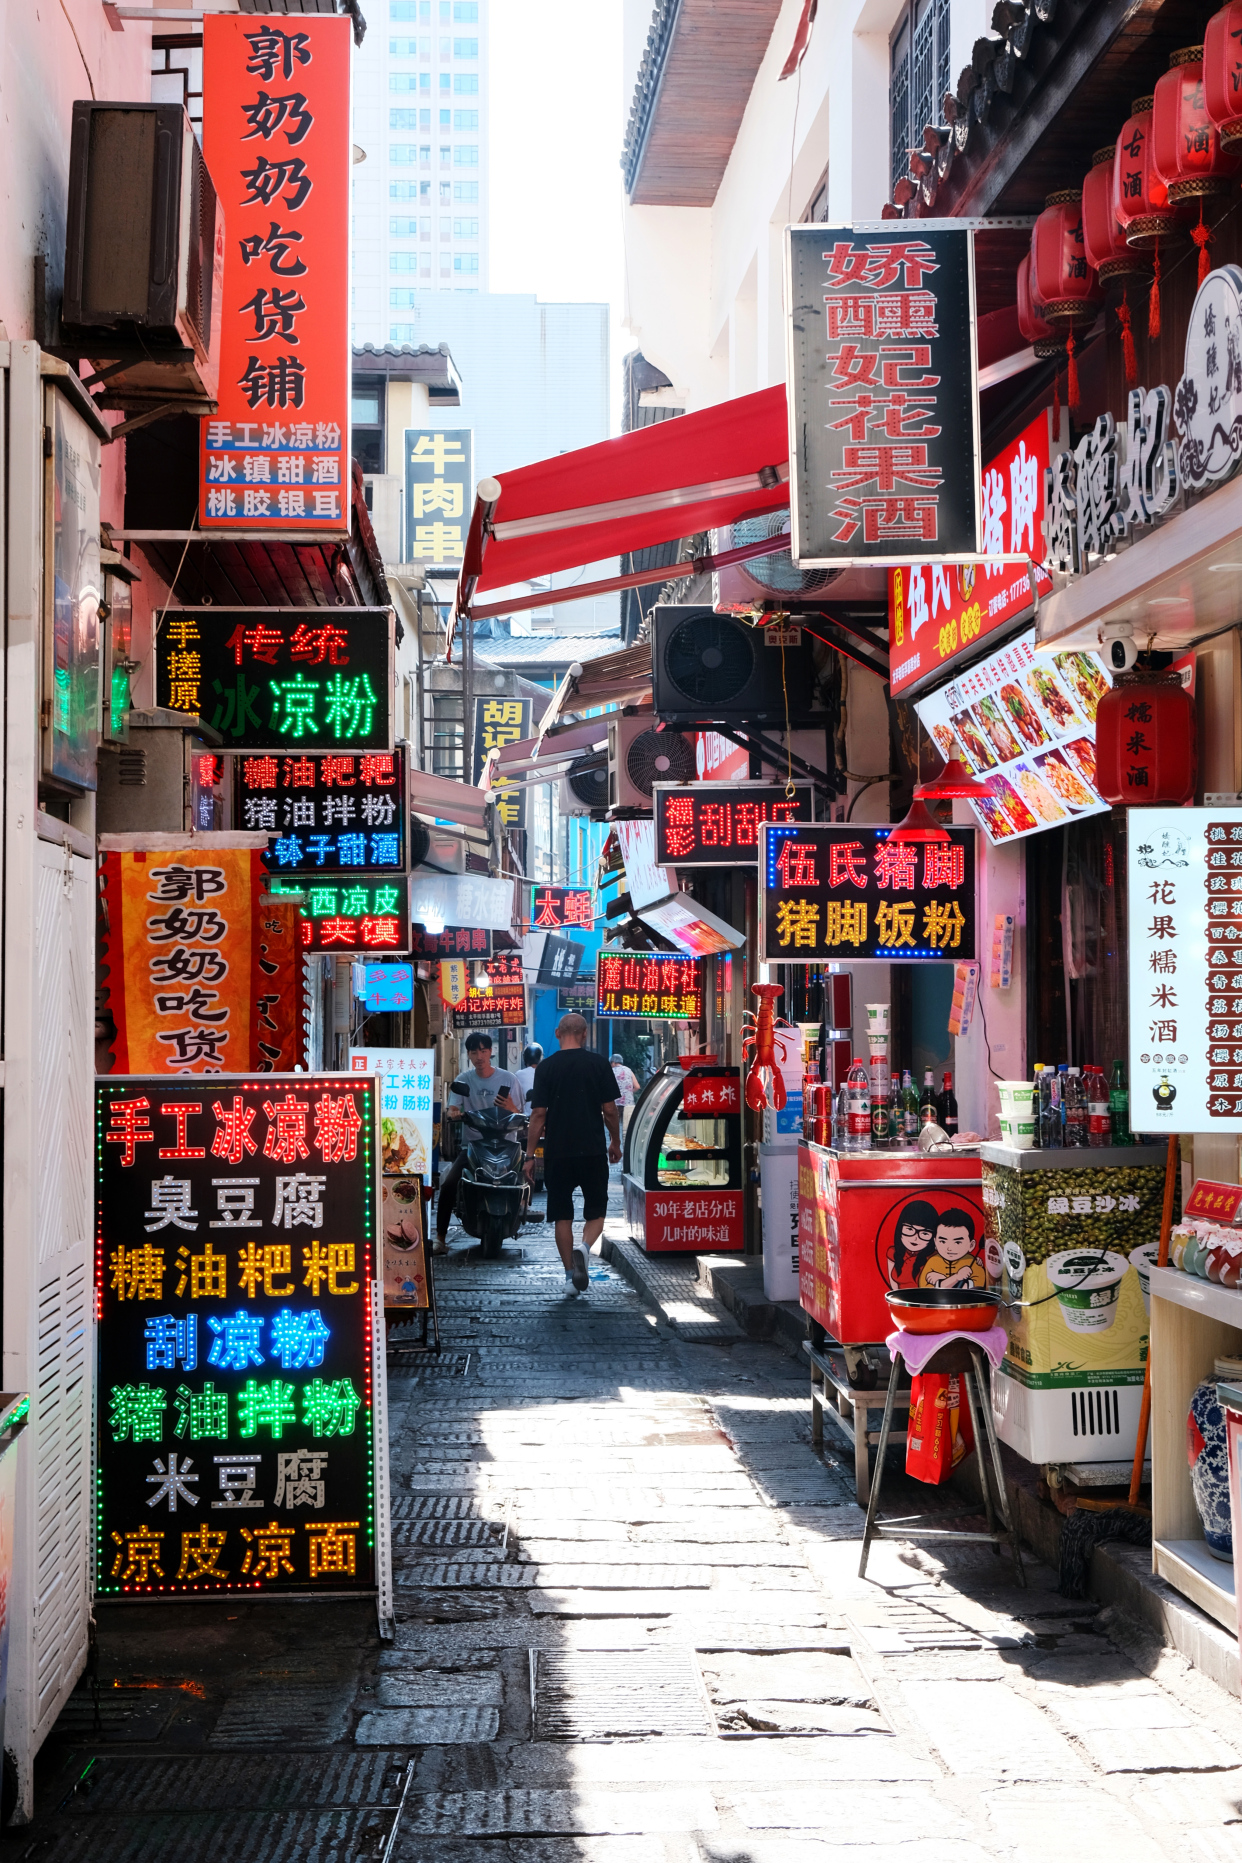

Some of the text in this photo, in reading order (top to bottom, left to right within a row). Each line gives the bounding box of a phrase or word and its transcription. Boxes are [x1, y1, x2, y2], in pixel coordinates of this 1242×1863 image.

[1123, 128, 1145, 198] 古酒
[238, 24, 314, 411] 郭奶奶吃货铺
[822, 240, 944, 544] 娇醺妃花果酒
[206, 421, 341, 450] 手工冰凉粉
[208, 455, 341, 485] 冰镇甜酒
[207, 489, 341, 519] 桃胶银耳
[410, 435, 466, 564] 牛肉串
[166, 620, 202, 718] 手搓原
[225, 623, 350, 666] 传统
[210, 672, 378, 739] 冰凉粉
[1123, 701, 1153, 788] 糯米酒
[243, 755, 397, 790] 糖油粑粑
[243, 794, 397, 829] 猪油拌粉
[699, 802, 801, 848] 刮刮
[776, 840, 965, 890] 伍氏猪脚
[280, 884, 400, 917] 西凉皮
[775, 899, 966, 948] 猪脚饭粉
[1211, 927, 1242, 940] 百香
[148, 865, 229, 1074] 郭奶奶吃货
[1145, 879, 1181, 1044] 花果糯米酒
[603, 993, 698, 1014] 儿时的味道
[381, 1074, 431, 1090] 工米粉
[402, 1095, 431, 1111] 肠粉
[686, 1085, 736, 1106] 炸炸炸
[105, 1092, 362, 1168] 手工冰凉粉
[143, 1173, 327, 1233] 臭豆腐
[653, 1200, 736, 1219] 30年老店分店
[660, 1224, 730, 1243] 儿时的味道
[108, 1241, 360, 1302] 糖油粑粑
[144, 1309, 331, 1371] 刮凉粉
[107, 1377, 362, 1443] 猪油拌粉
[145, 1448, 329, 1513] 米豆腐
[109, 1520, 361, 1582] 凉皮凉面
